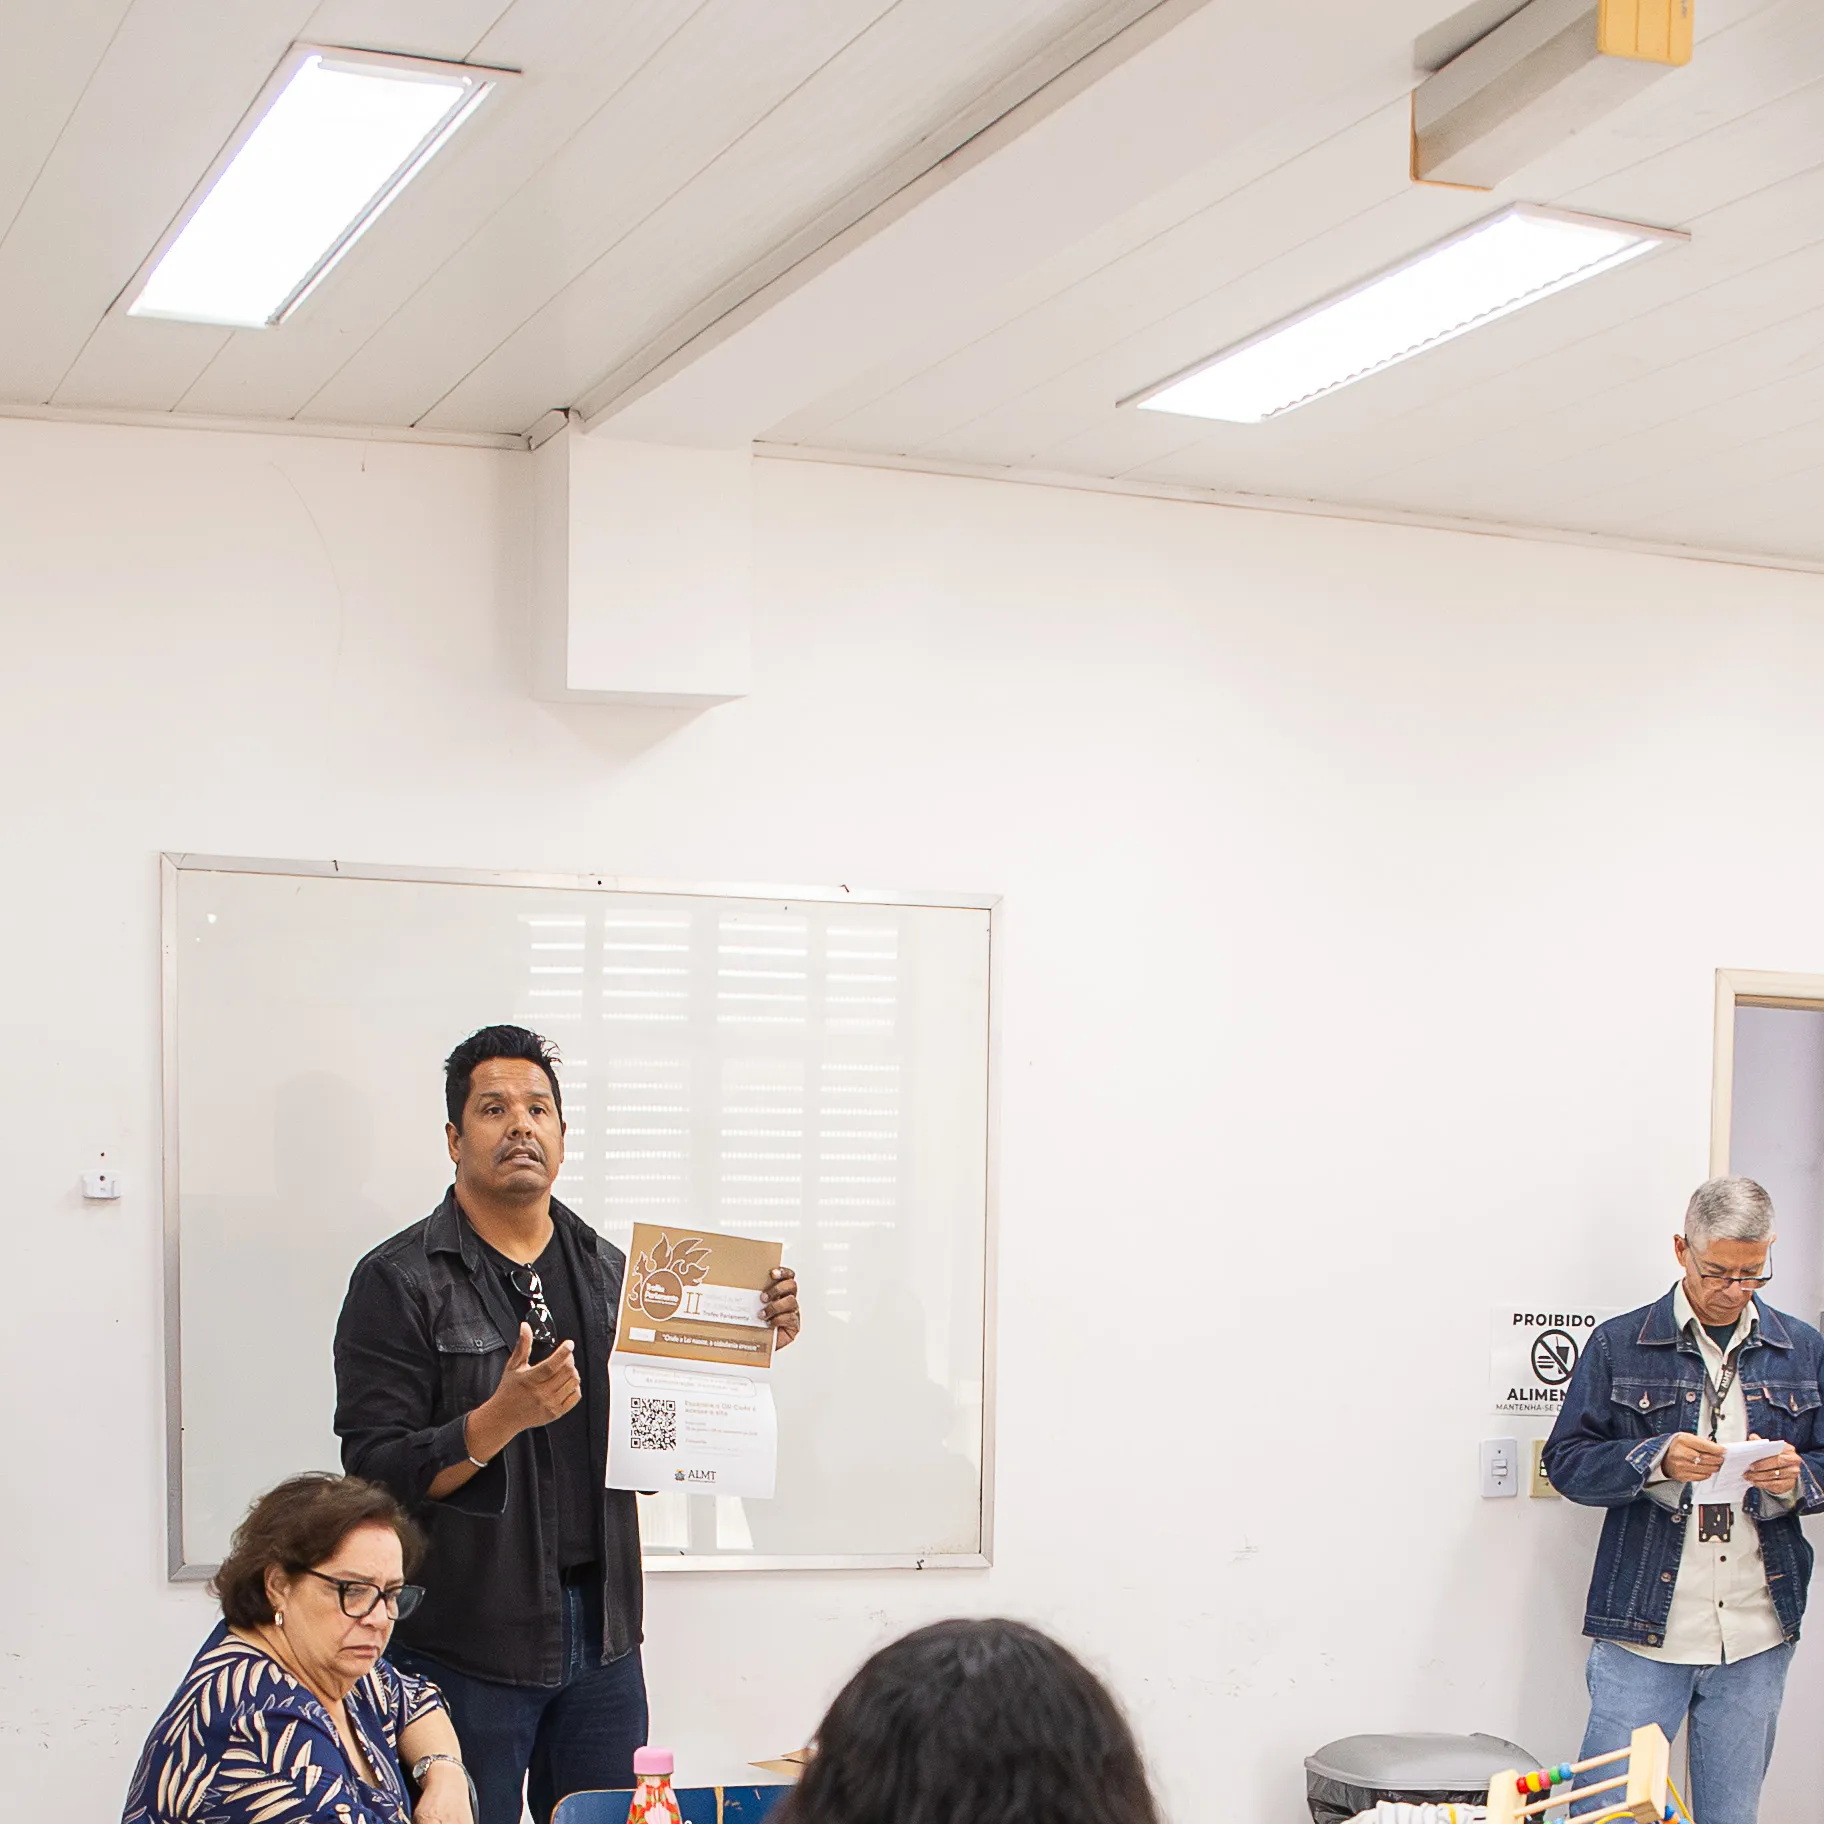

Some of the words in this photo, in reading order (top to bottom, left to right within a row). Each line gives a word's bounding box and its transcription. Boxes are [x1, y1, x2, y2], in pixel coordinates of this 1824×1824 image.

[1512, 1313, 1596, 1328] PROIBIDO
[1495, 1403, 1554, 1412] MANTENHA-SE
[688, 1469, 717, 1481] ALMT
